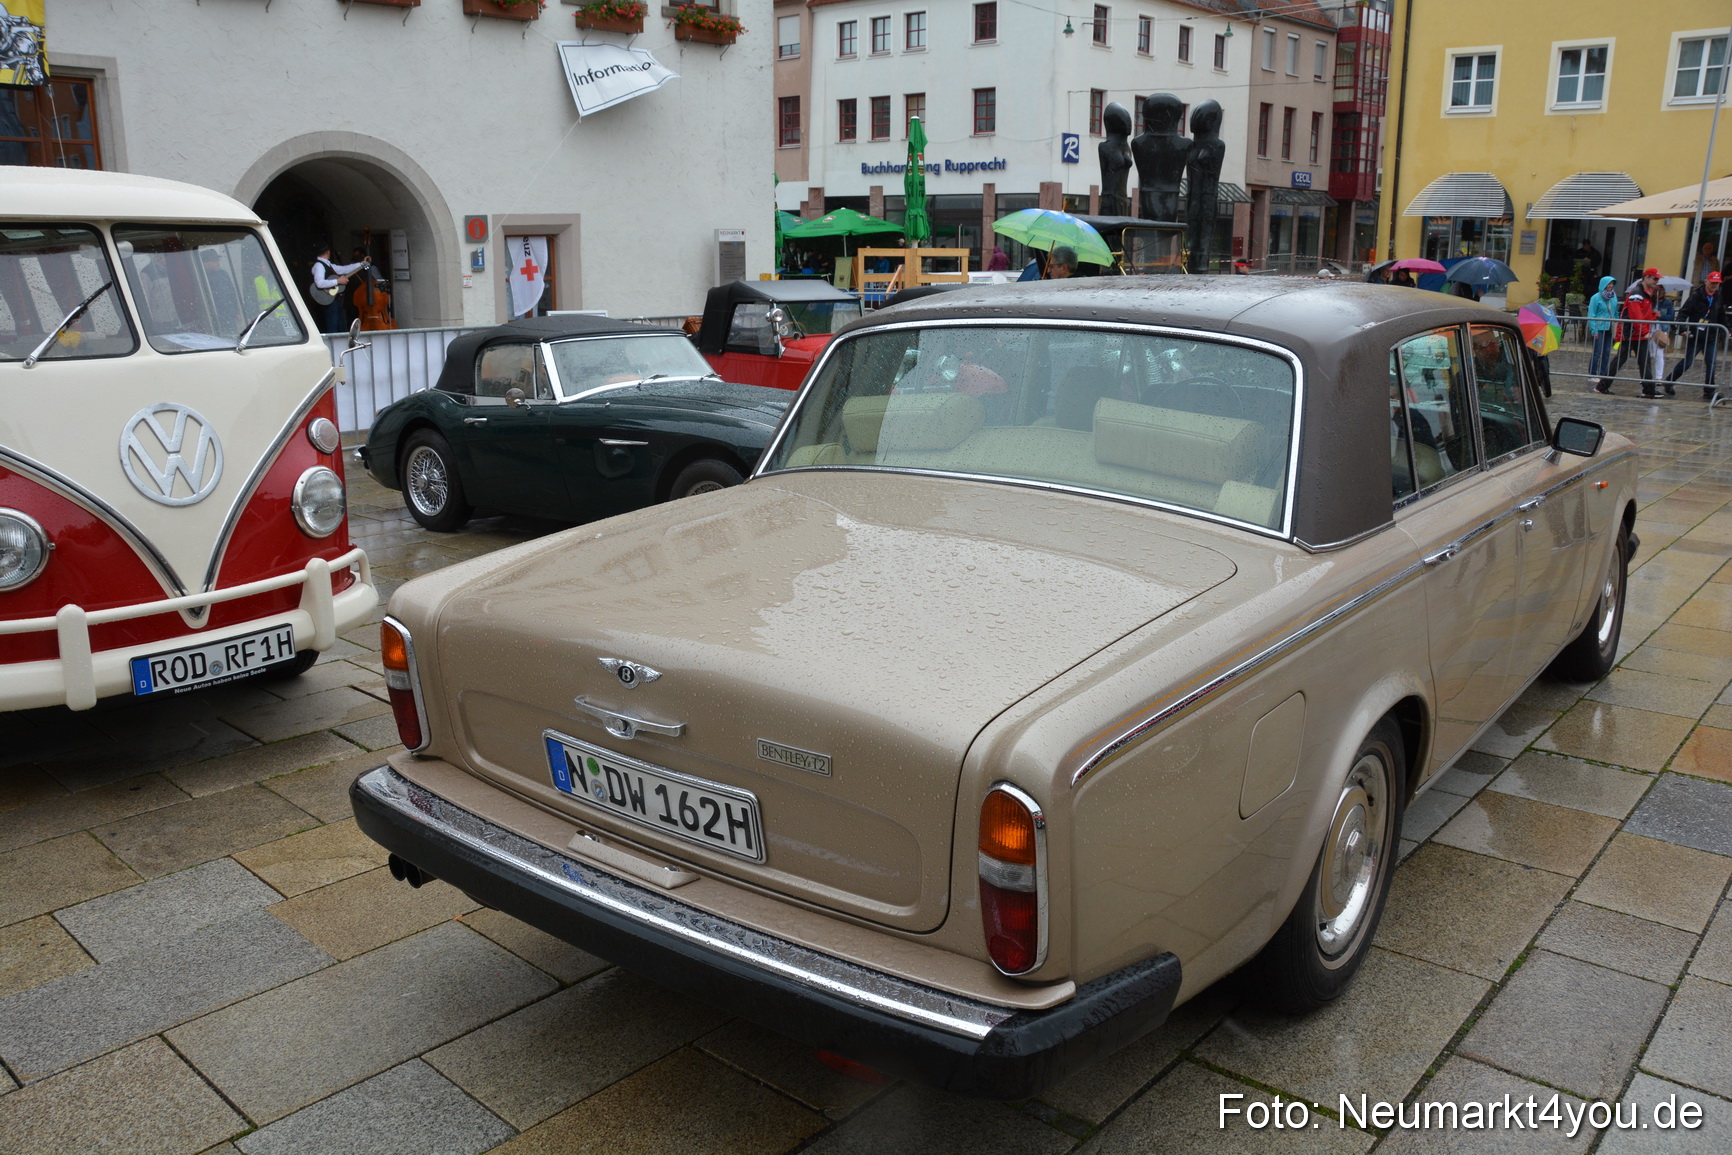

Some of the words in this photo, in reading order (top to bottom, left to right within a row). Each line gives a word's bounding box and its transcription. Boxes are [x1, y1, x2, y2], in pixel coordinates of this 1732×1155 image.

[1064, 136, 1079, 160] R
[861, 161, 942, 176] Buchhanng
[945, 157, 1007, 175] Rupprecht
[1295, 172, 1311, 184] CECIL
[122, 405, 220, 504] VW
[151, 652, 207, 688] ROD
[174, 686, 192, 694] Neue
[193, 682, 212, 690] Autos
[213, 677, 232, 685] haben
[232, 673, 250, 681] keine
[250, 667, 267, 676] Seele
[621, 667, 632, 682] B
[139, 680, 147, 689] D
[761, 744, 809, 767] BENTLEY
[811, 757, 826, 772] T2
[557, 769, 566, 781] D
[565, 750, 589, 794] N
[602, 765, 647, 816] DW
[654, 784, 754, 850] 162H
